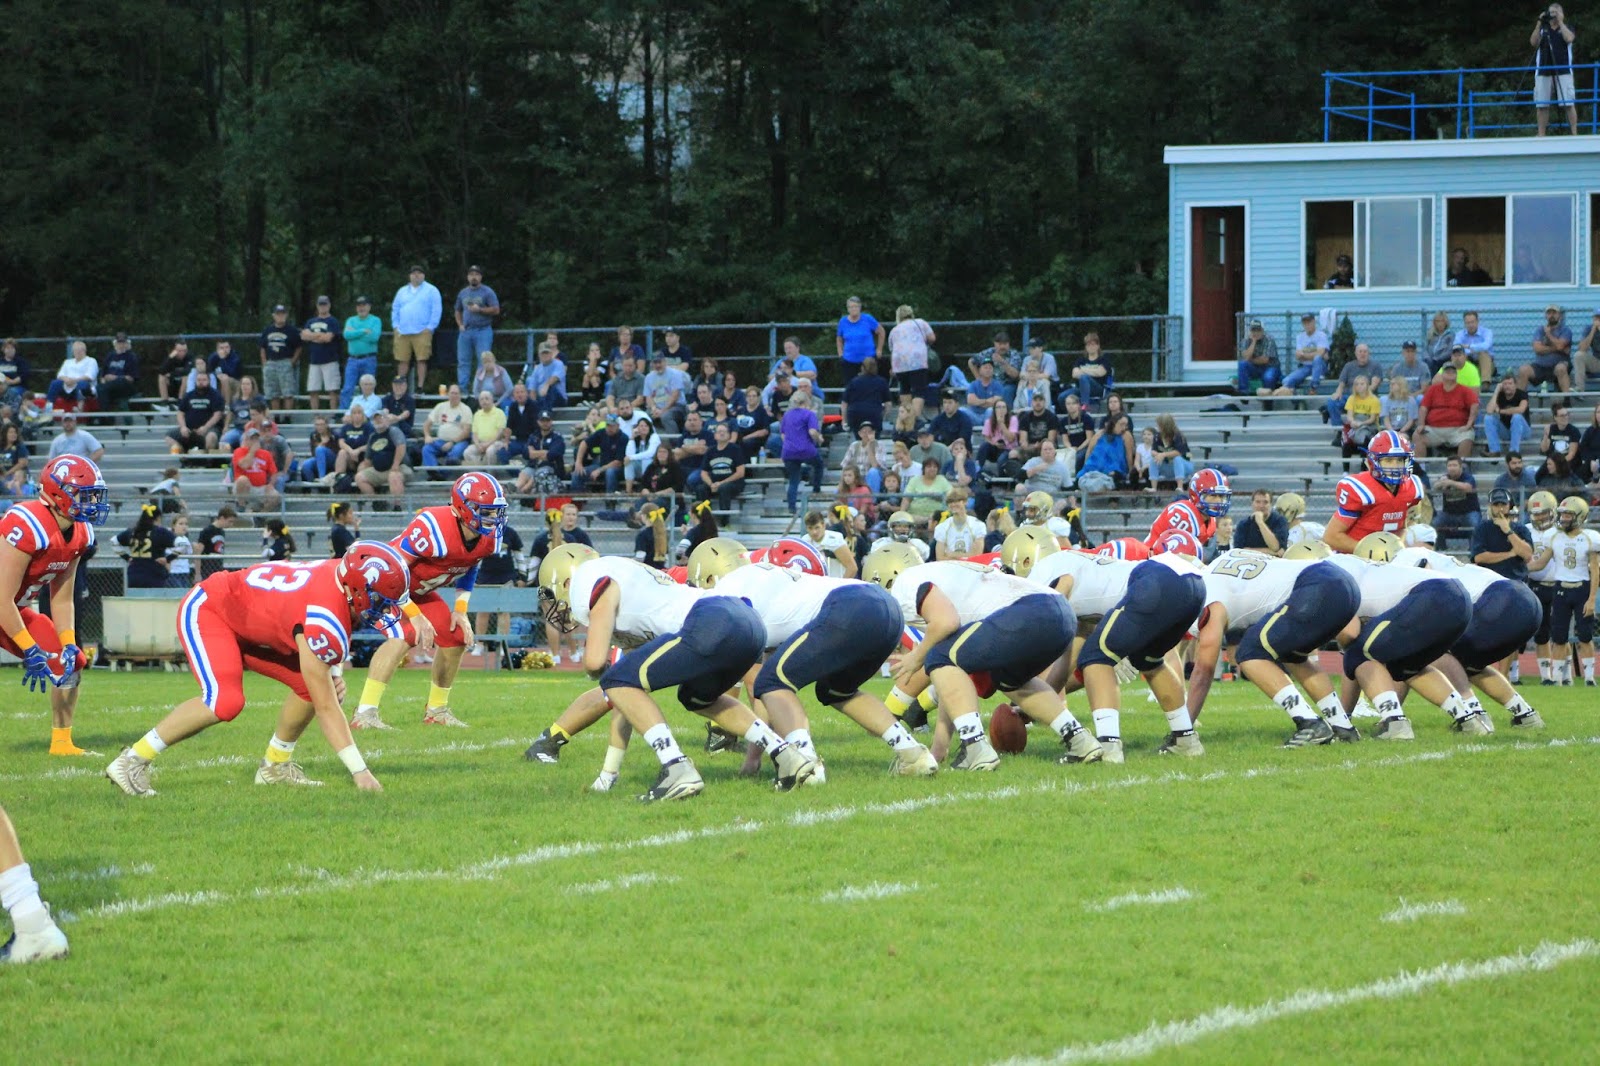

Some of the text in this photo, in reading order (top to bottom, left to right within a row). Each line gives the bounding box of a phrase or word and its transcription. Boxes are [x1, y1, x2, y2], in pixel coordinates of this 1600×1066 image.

[1339, 489, 1348, 505] 5
[1169, 513, 1189, 532] 20
[6, 526, 23, 547] 2
[409, 527, 429, 553] 40
[130, 538, 152, 558] 22
[1563, 547, 1577, 570] 3
[307, 633, 338, 664] 33
